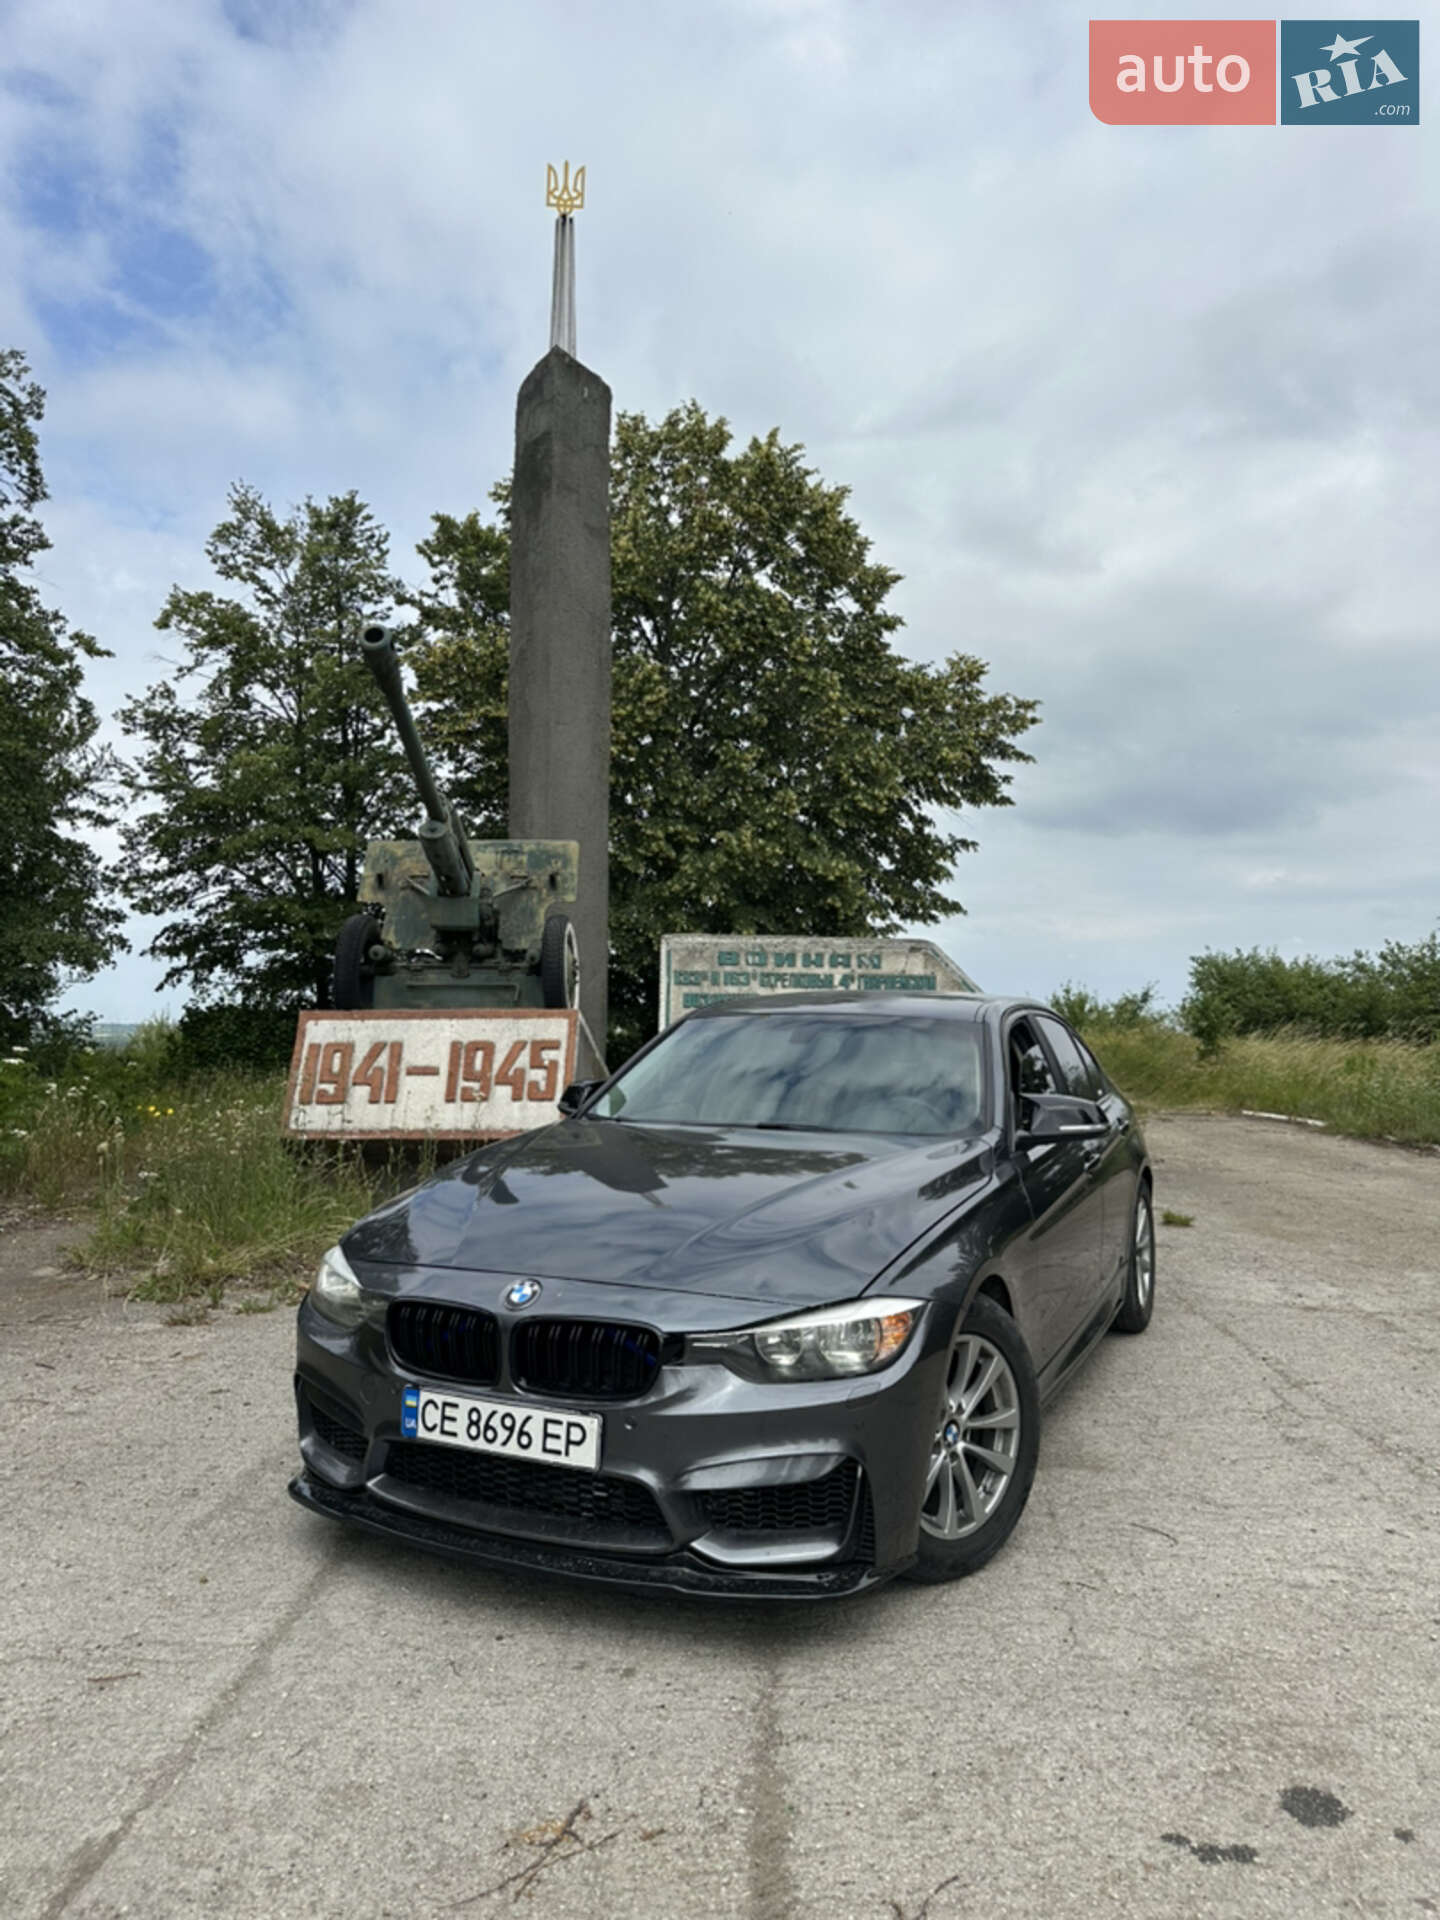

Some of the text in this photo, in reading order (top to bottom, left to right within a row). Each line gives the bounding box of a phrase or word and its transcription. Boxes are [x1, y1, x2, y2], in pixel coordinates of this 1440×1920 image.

[717, 950, 882, 969] ВОИНАМ
[404, 1416, 418, 1430] UA
[421, 1399, 587, 1457] CE 8696 EP
